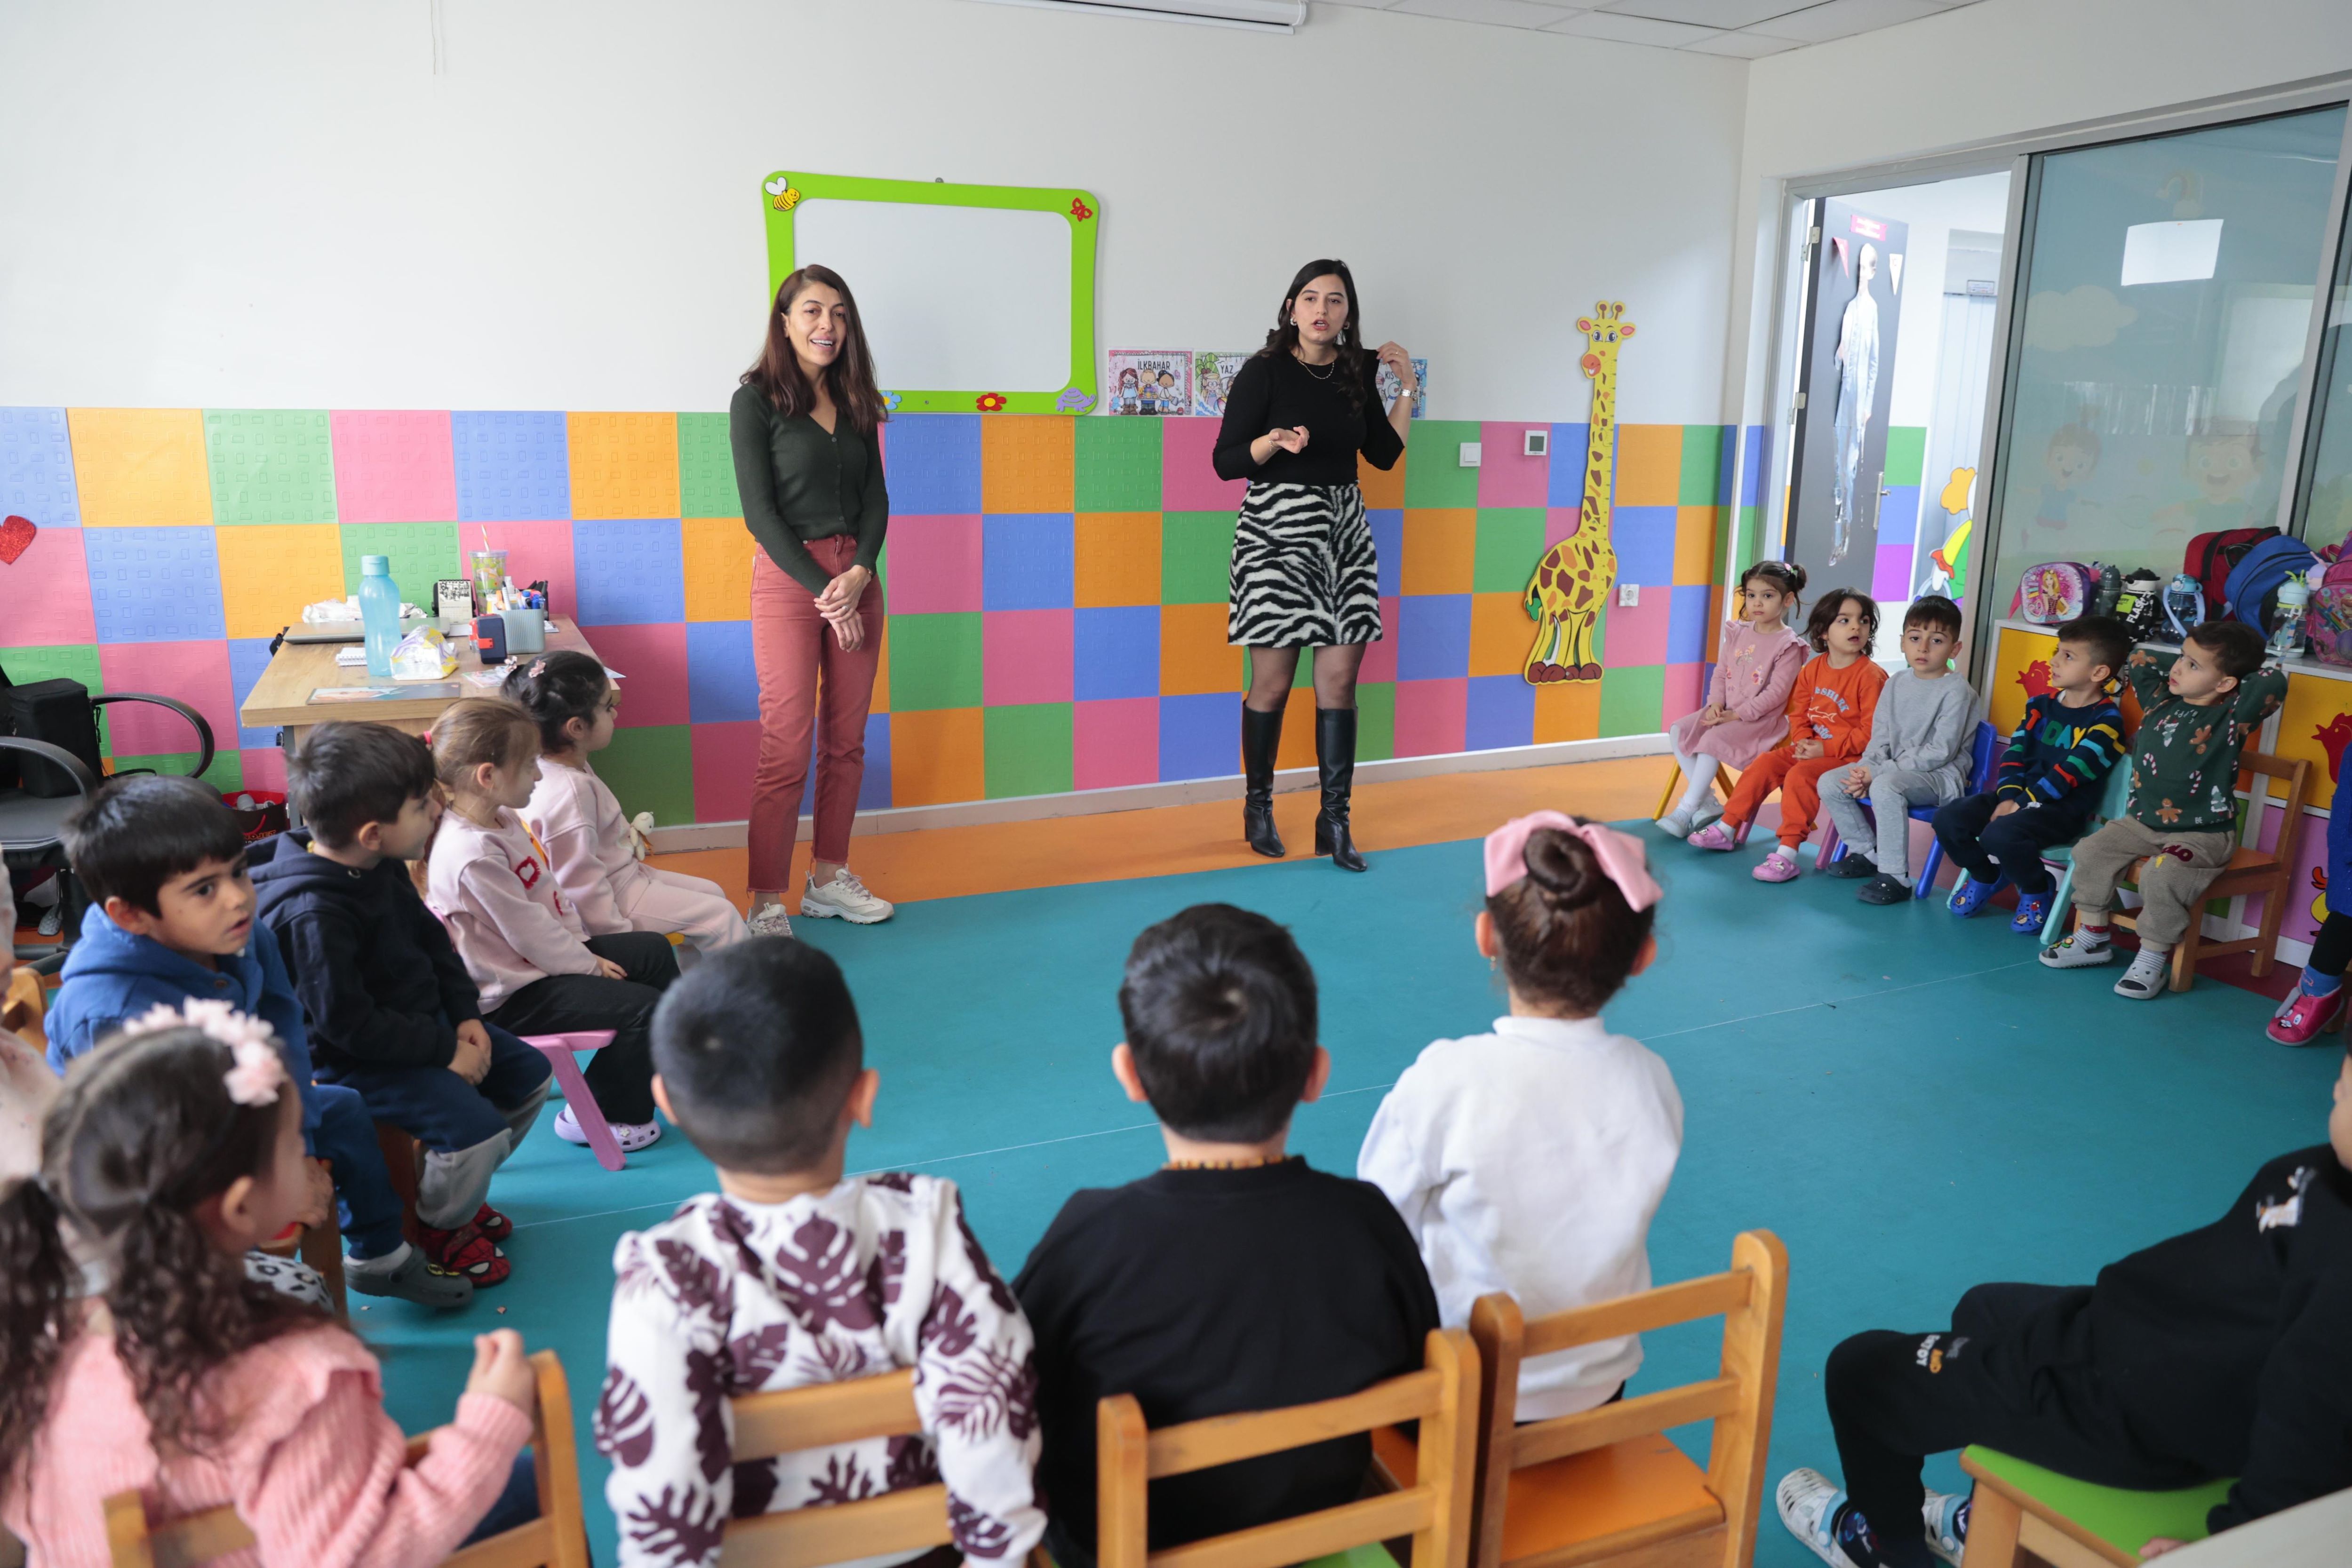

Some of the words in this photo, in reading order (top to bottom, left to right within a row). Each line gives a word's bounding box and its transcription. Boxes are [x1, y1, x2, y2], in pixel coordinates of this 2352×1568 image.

[1138, 359, 1170, 370] İLKBAHAR
[1220, 365, 1233, 374] YAZ
[2025, 709, 2086, 749] TODAY
